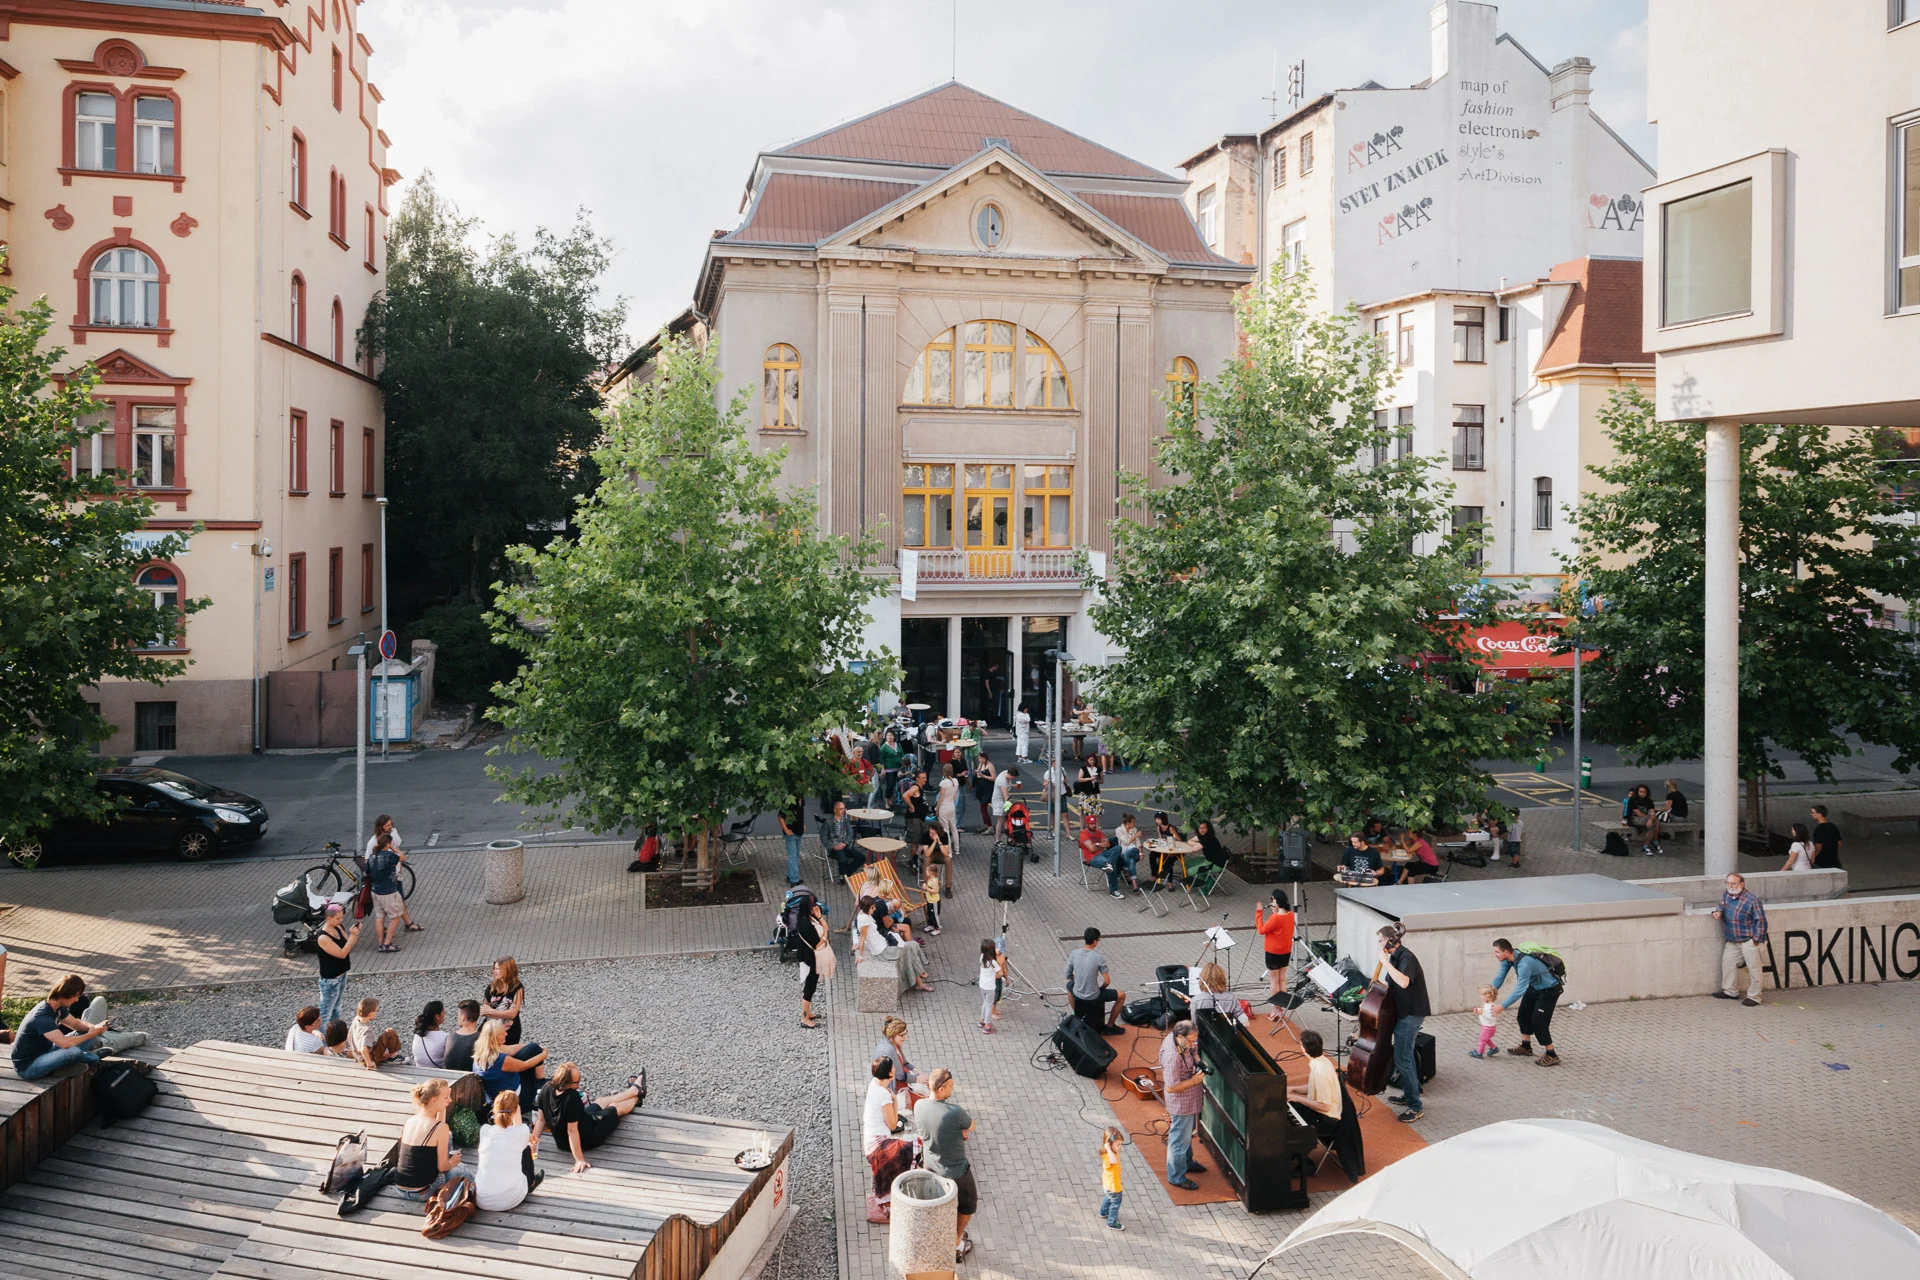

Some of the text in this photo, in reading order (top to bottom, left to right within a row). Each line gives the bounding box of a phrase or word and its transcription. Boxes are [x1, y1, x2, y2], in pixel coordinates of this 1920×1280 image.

[1460, 80, 1509, 96] map of
[1460, 99, 1514, 117] fashion
[1383, 148, 1450, 192] ZNAČEK
[1459, 167, 1542, 184] ArtDivision
[1476, 634, 1565, 653] Coca-Col
[1736, 922, 1920, 989] ARKING
